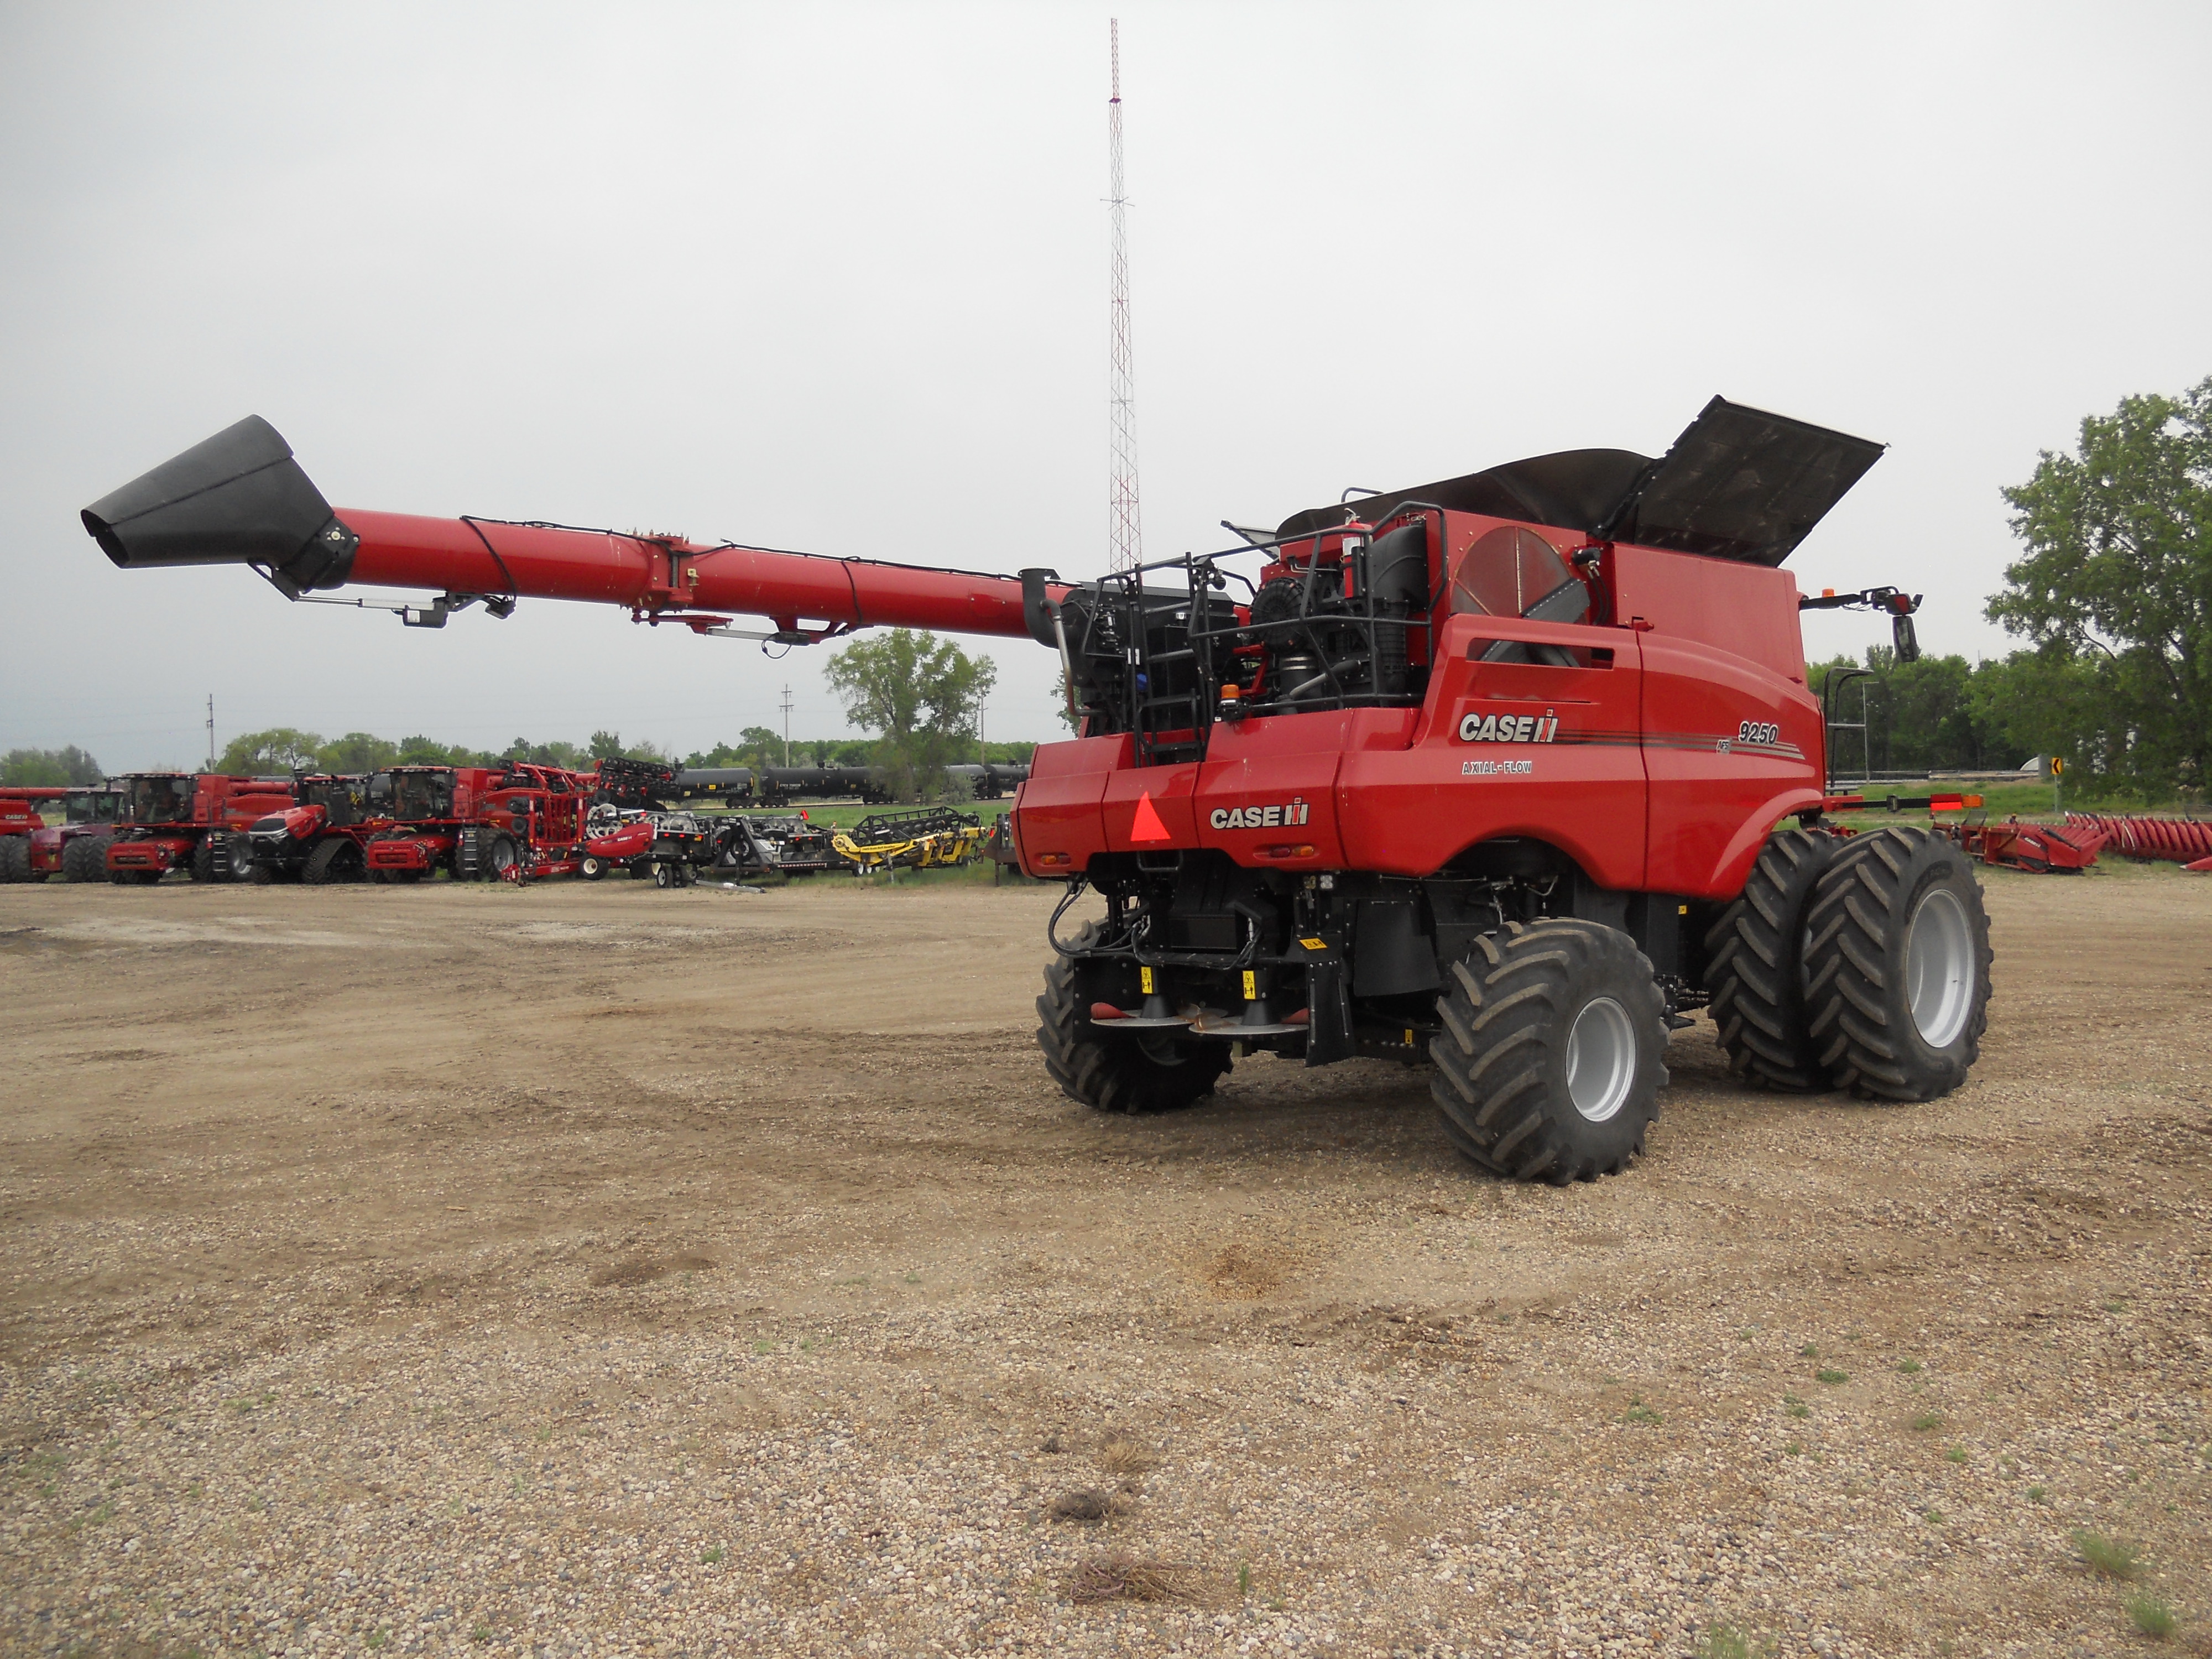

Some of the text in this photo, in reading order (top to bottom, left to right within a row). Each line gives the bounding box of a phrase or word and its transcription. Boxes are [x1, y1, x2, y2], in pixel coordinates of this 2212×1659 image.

[1459, 713, 1534, 742] CASE
[1738, 720, 1778, 745] 9250
[1462, 761, 1532, 775] AXIAL-FLOW
[1210, 805, 1281, 829] CASE
